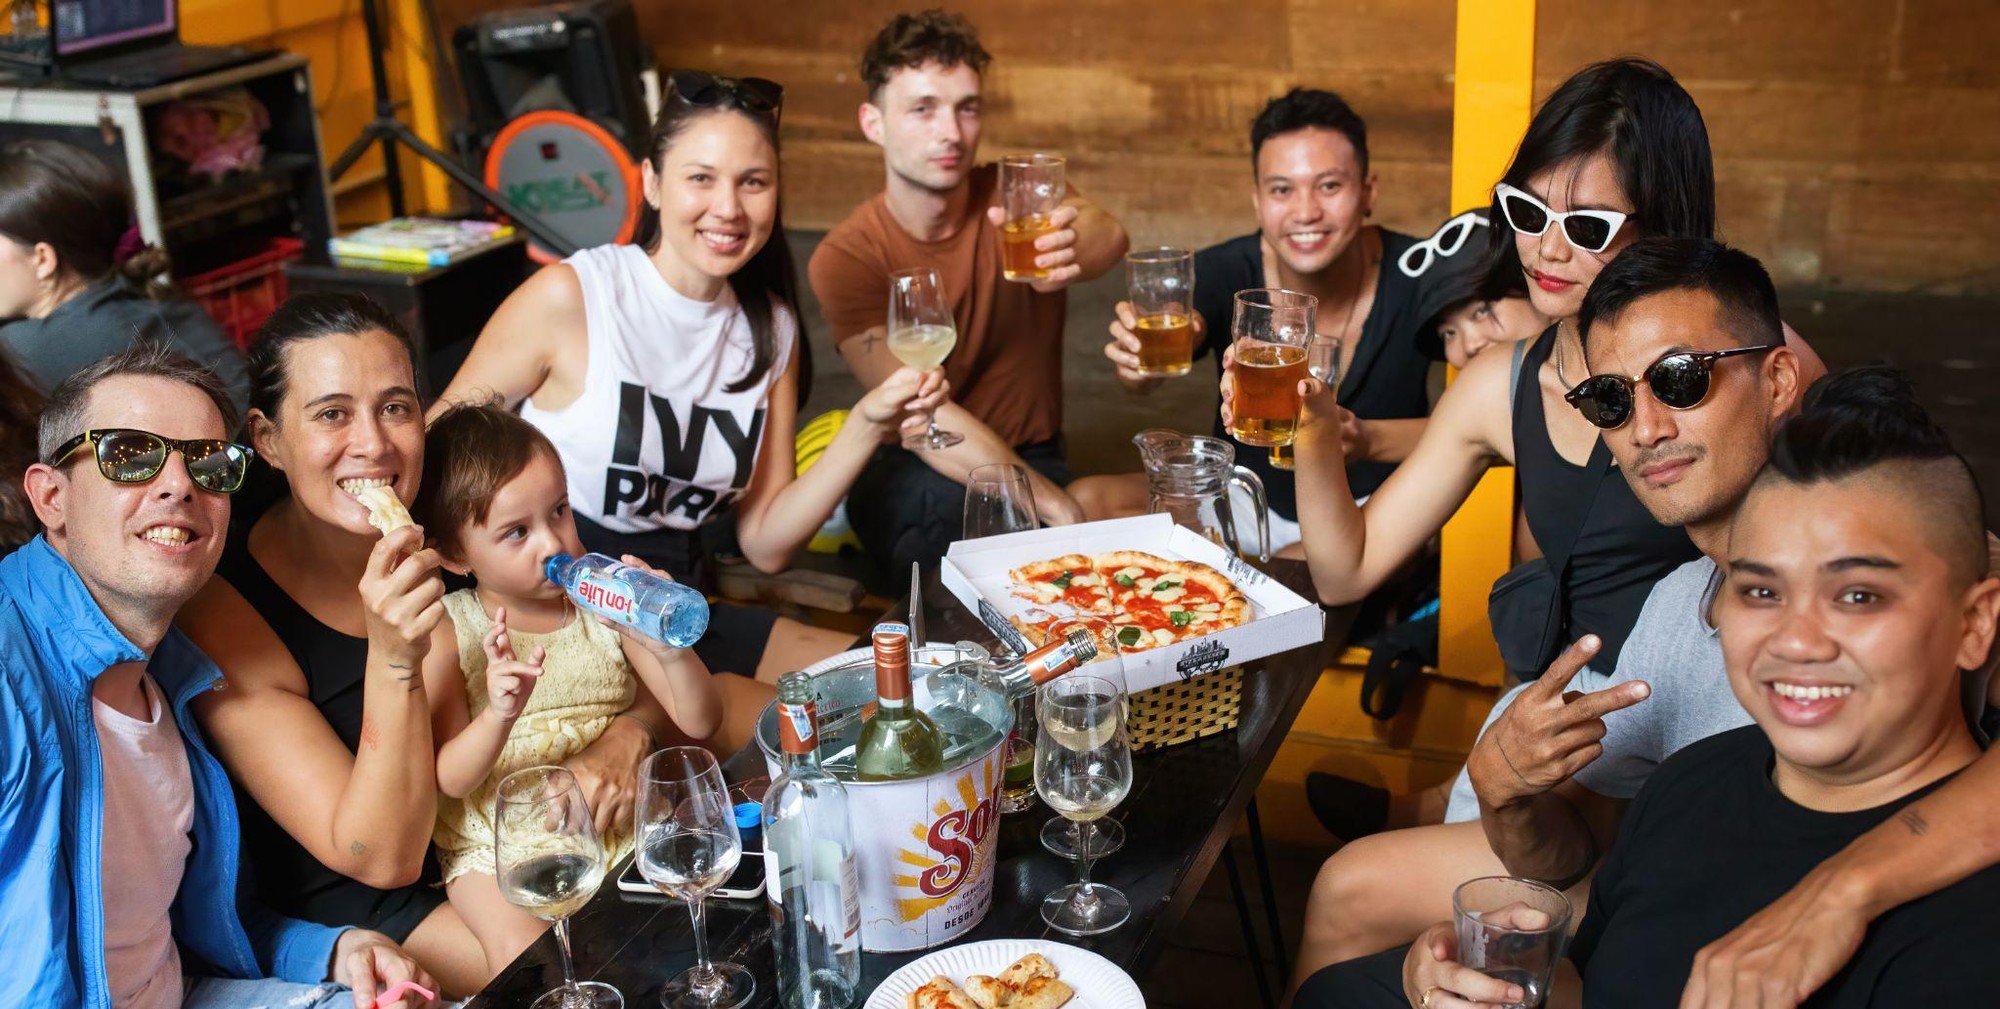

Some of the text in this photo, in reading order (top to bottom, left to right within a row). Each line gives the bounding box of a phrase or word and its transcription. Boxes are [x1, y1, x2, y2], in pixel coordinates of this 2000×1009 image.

[611, 381, 767, 489] IVY
[918, 781, 1002, 898] Sol
[944, 907, 975, 930] DESDE
